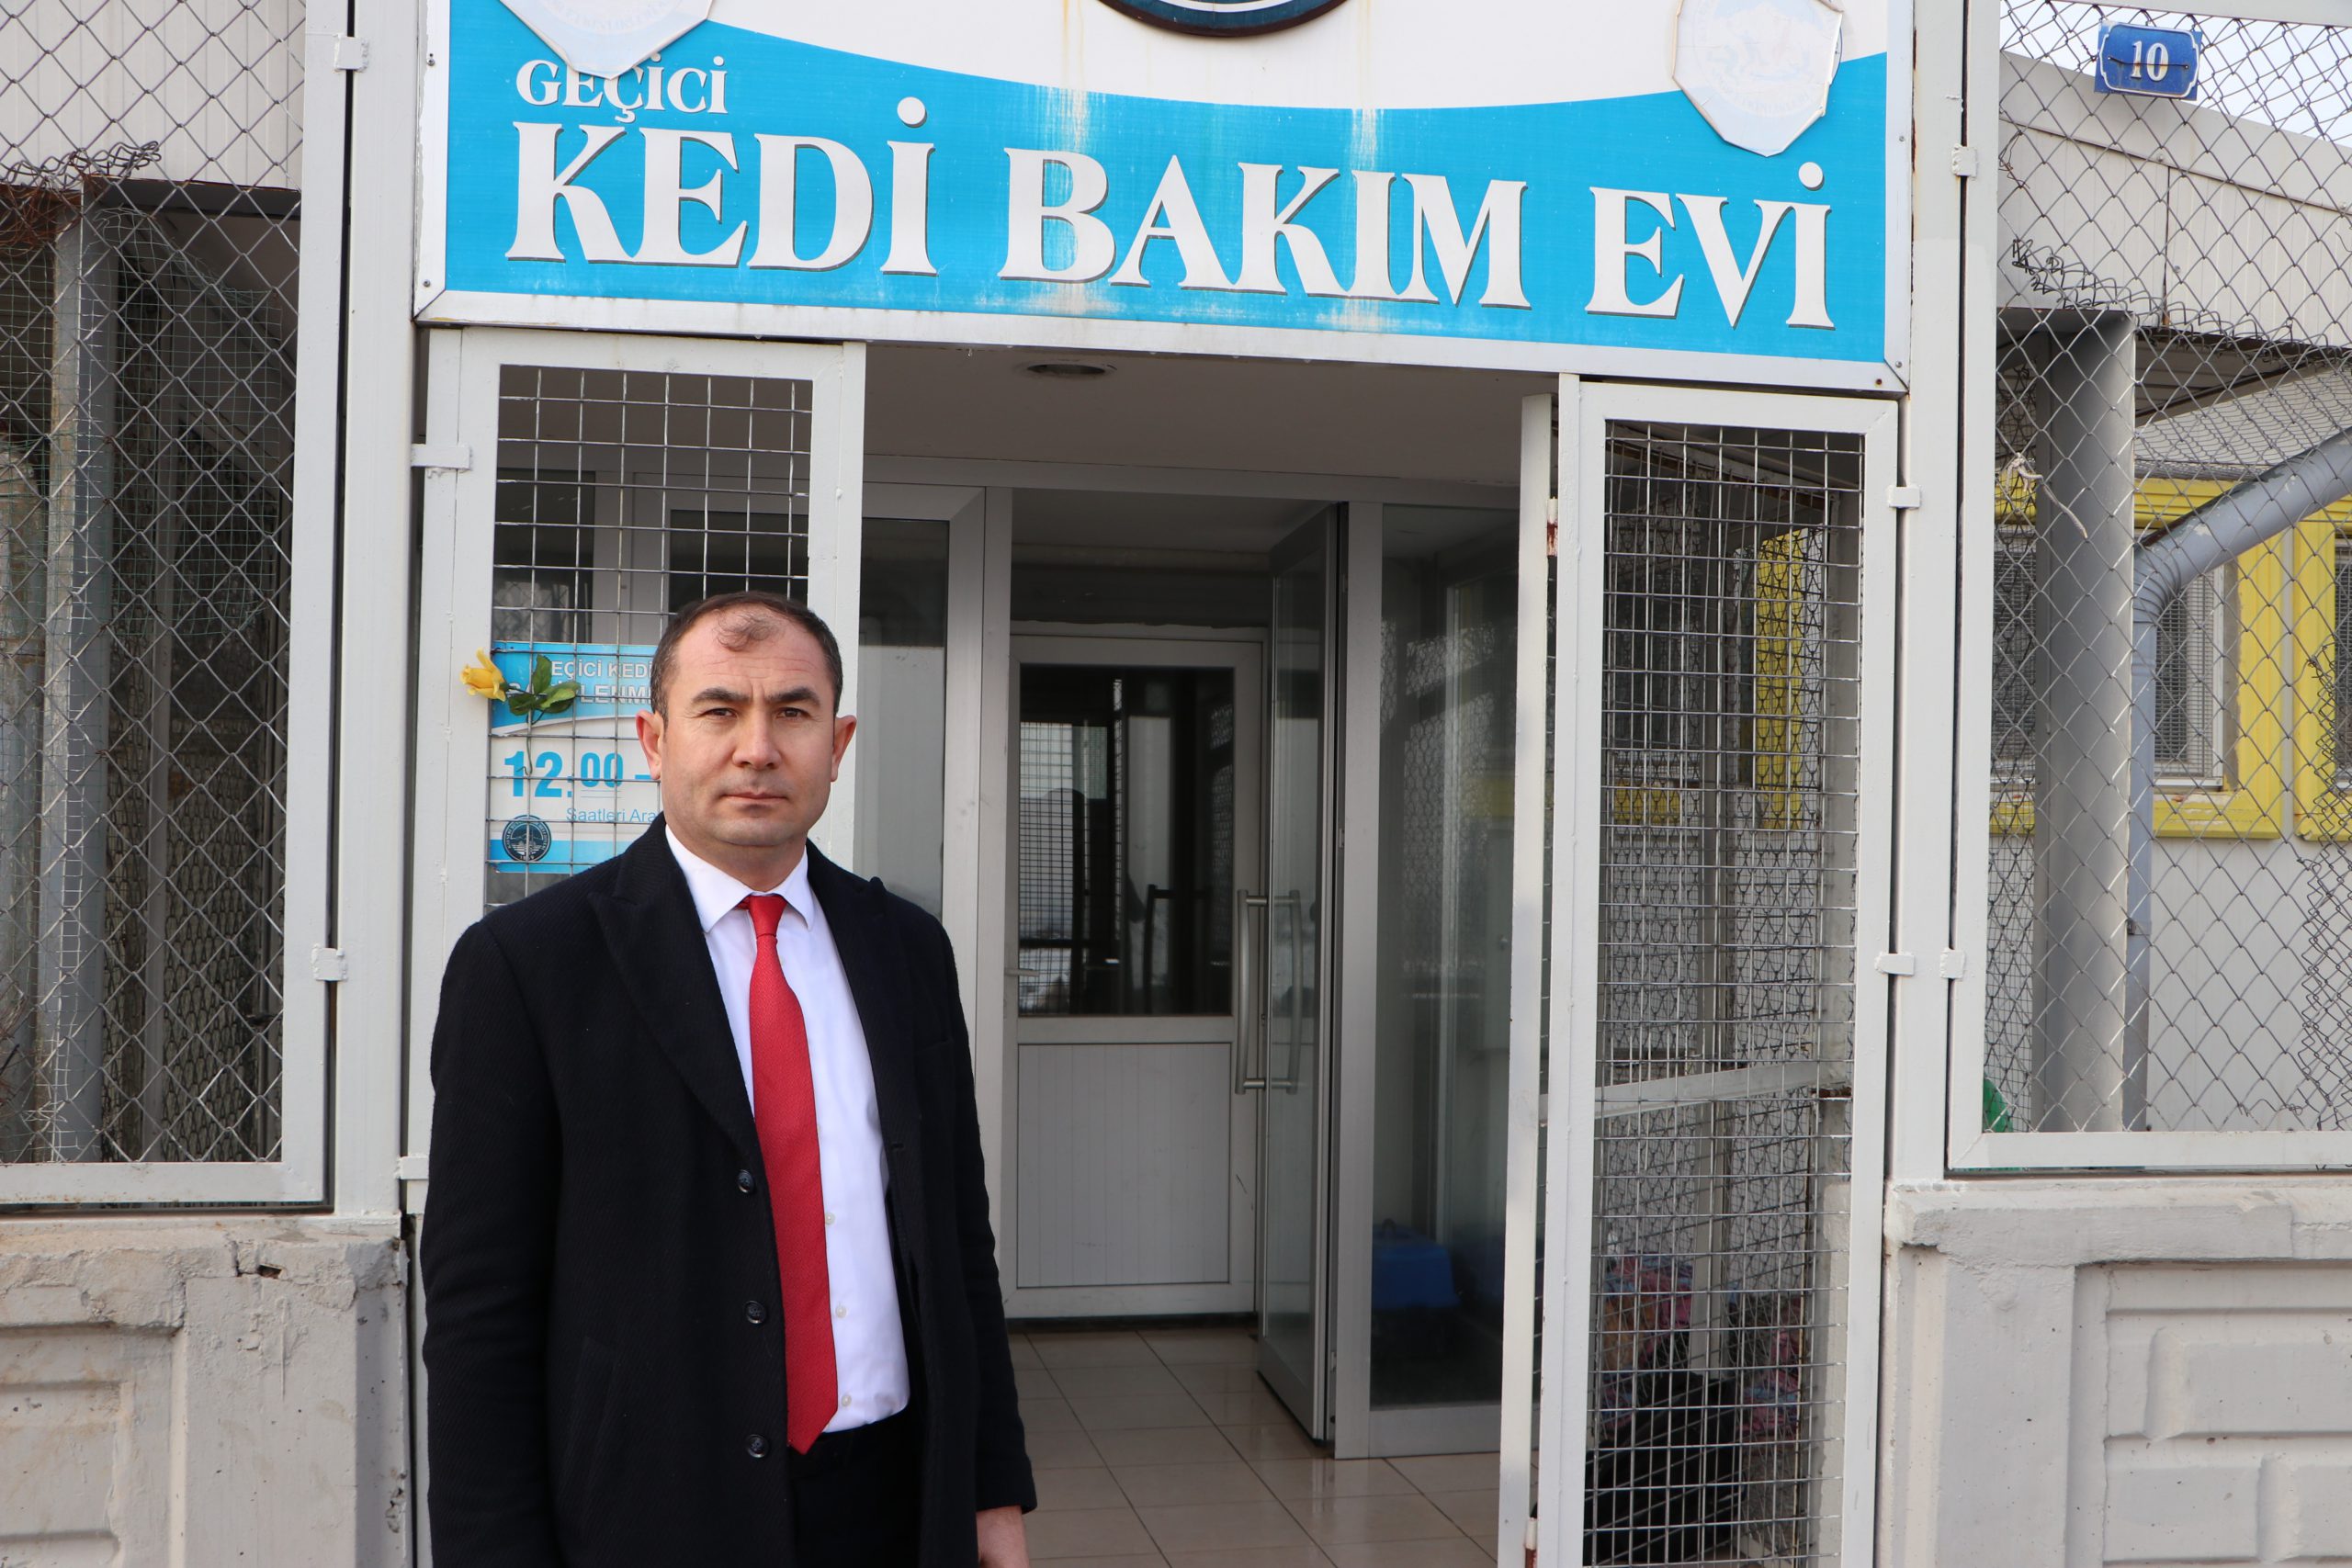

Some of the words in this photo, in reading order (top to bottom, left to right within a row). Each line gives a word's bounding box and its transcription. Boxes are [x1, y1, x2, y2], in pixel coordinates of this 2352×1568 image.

[2131, 40, 2169, 82] 10
[515, 53, 729, 123] GEÇİCİ
[505, 96, 938, 277] KEDİ
[998, 148, 1532, 310] BAKIM
[1585, 162, 1836, 331] EVİ
[550, 660, 602, 680] EÇİCİ
[566, 807, 626, 822] Saatleri
